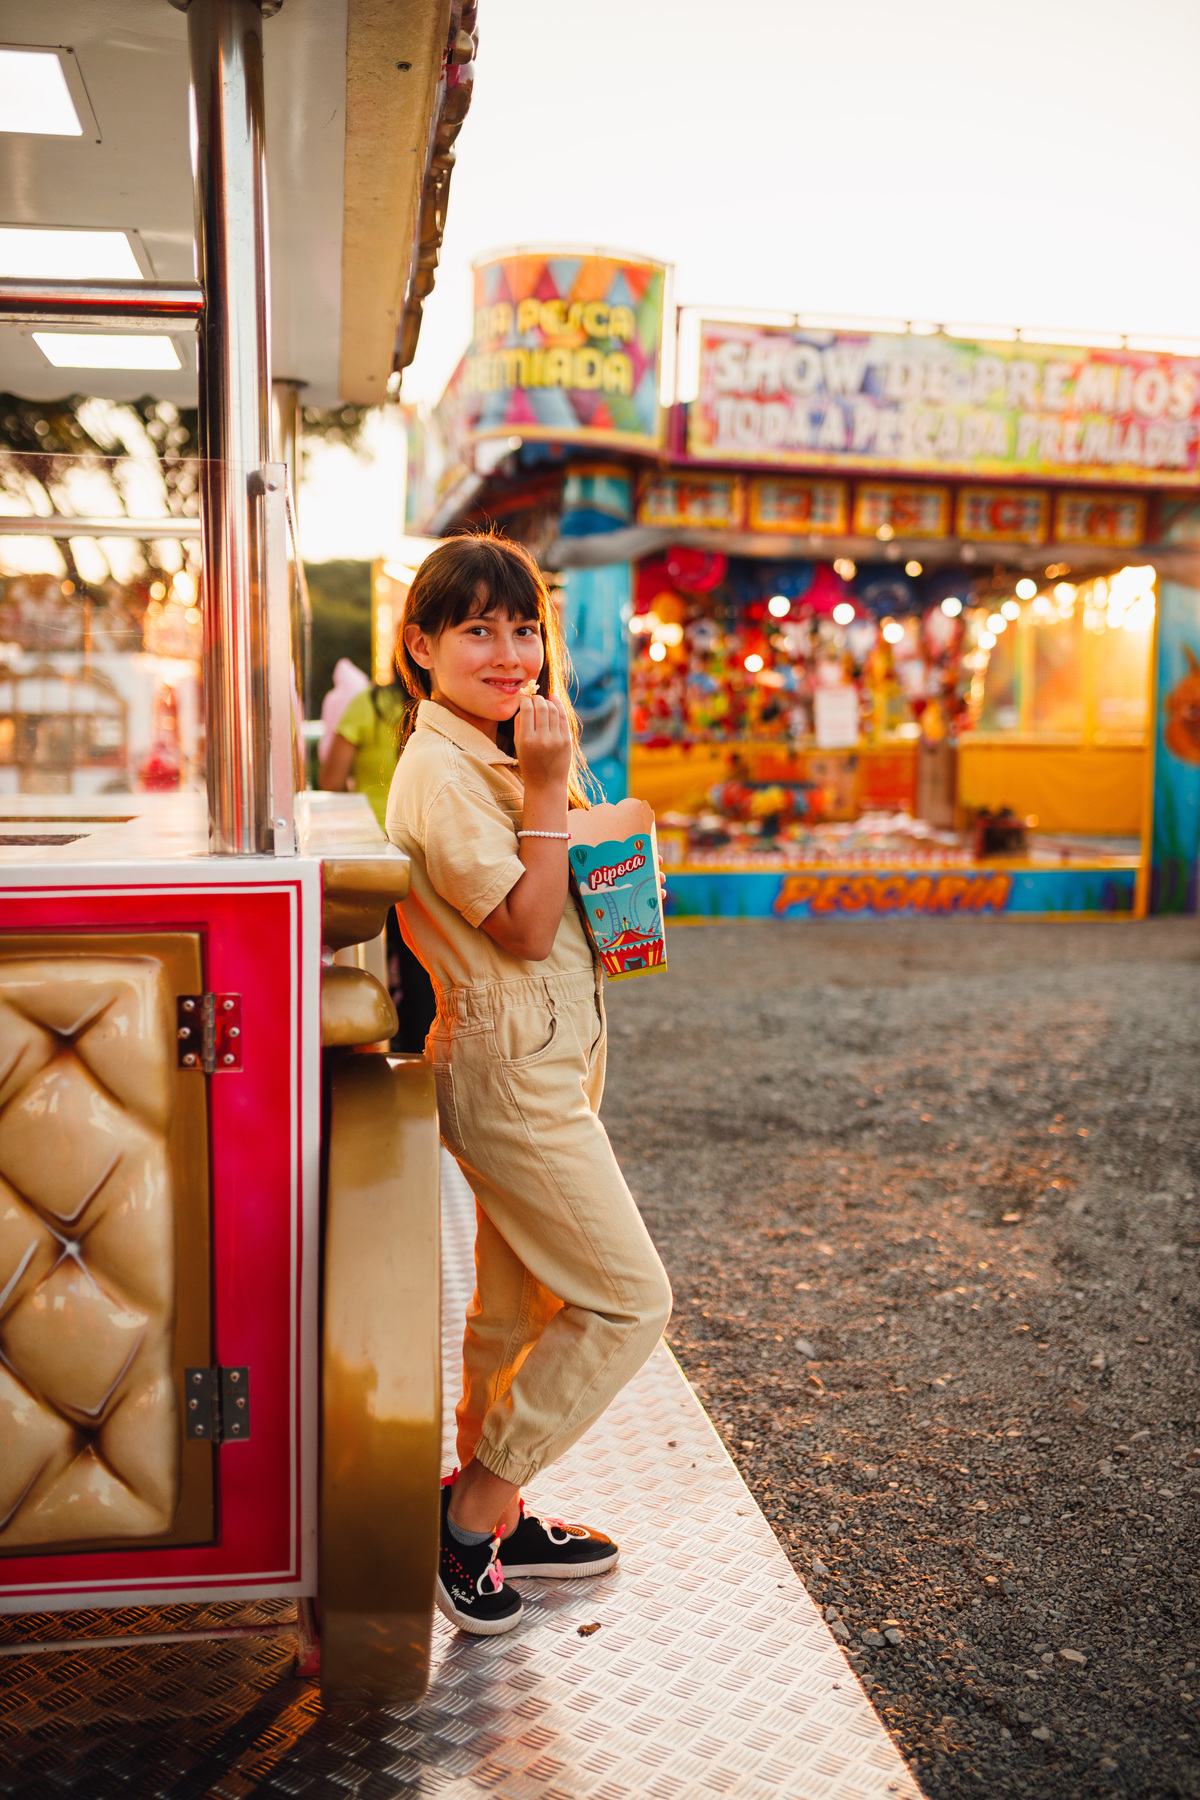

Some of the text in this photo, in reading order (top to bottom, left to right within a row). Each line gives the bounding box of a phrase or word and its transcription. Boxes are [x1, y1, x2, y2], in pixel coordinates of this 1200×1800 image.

[517, 299, 635, 343] PESCA
[713, 341, 867, 396] SHOW
[970, 356, 1197, 421] PREMIOS
[590, 855, 645, 889] Pipoca
[773, 873, 1013, 916] PESCARIA
